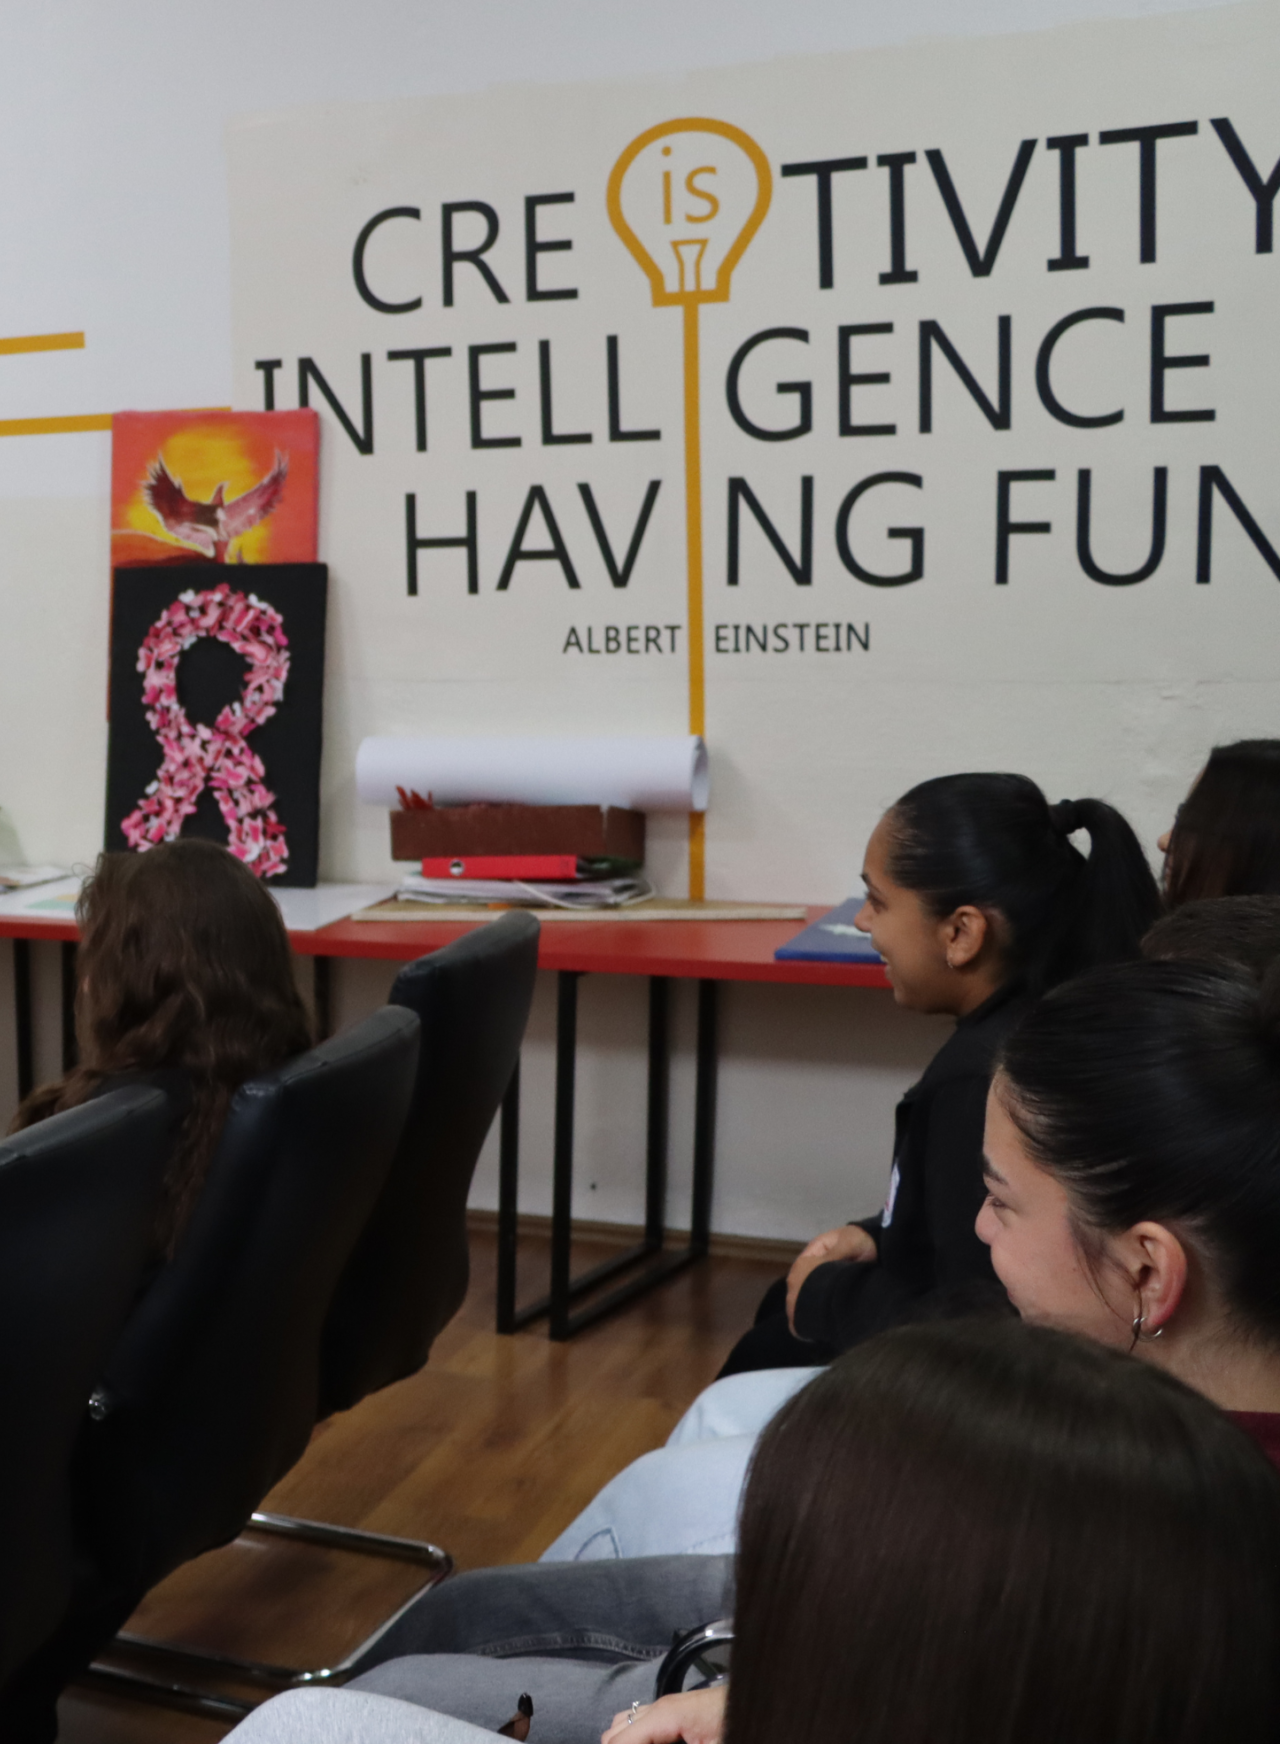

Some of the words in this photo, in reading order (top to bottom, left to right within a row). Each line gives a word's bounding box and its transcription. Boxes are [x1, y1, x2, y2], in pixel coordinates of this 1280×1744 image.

[352, 192, 580, 314] CRE
[724, 300, 1216, 442] GENCE
[994, 464, 1280, 587] FUN
[562, 625, 681, 654] ALBERT
[714, 622, 870, 654] EINSTEIN
